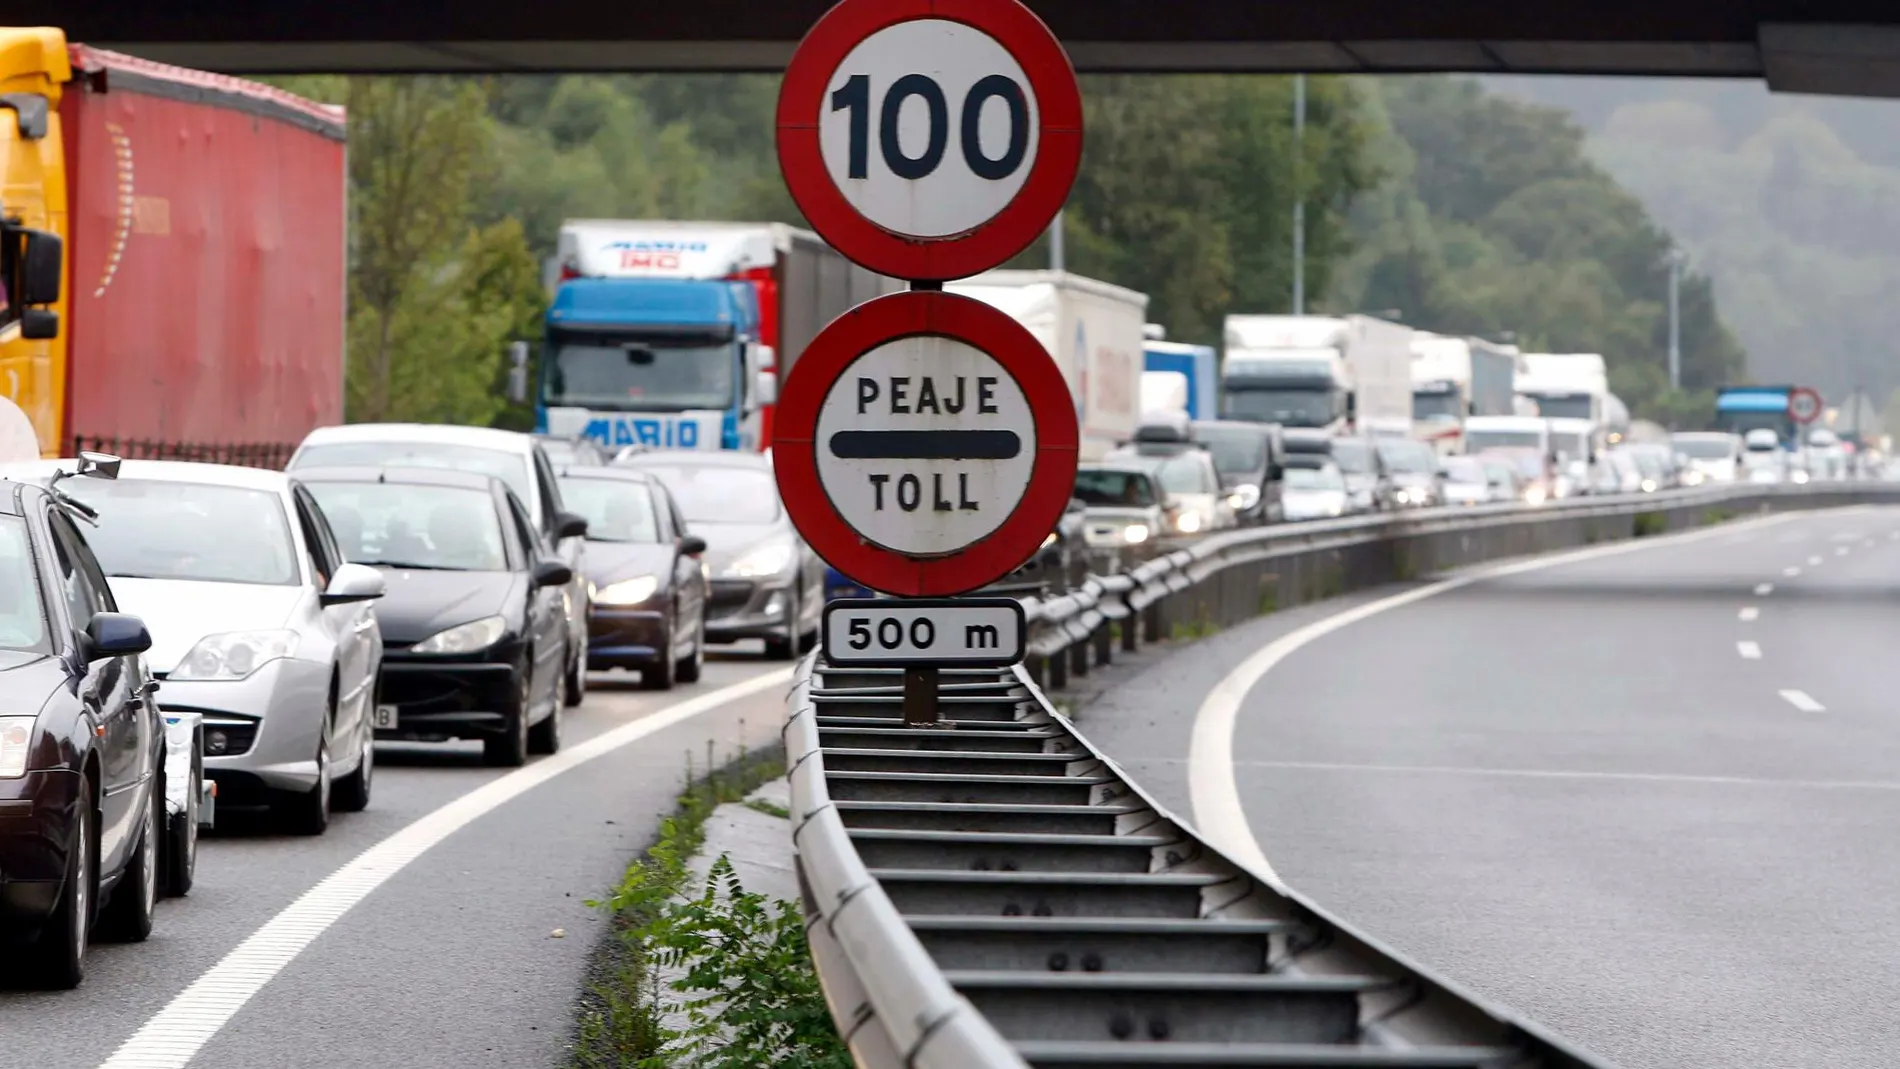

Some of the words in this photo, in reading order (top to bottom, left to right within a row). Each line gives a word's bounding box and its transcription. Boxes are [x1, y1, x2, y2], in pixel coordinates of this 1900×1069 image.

[831, 73, 1030, 180] 100
[857, 376, 999, 415] PEAJE
[869, 473, 979, 512] TOLL
[848, 616, 936, 651] 500
[965, 624, 999, 649] m
